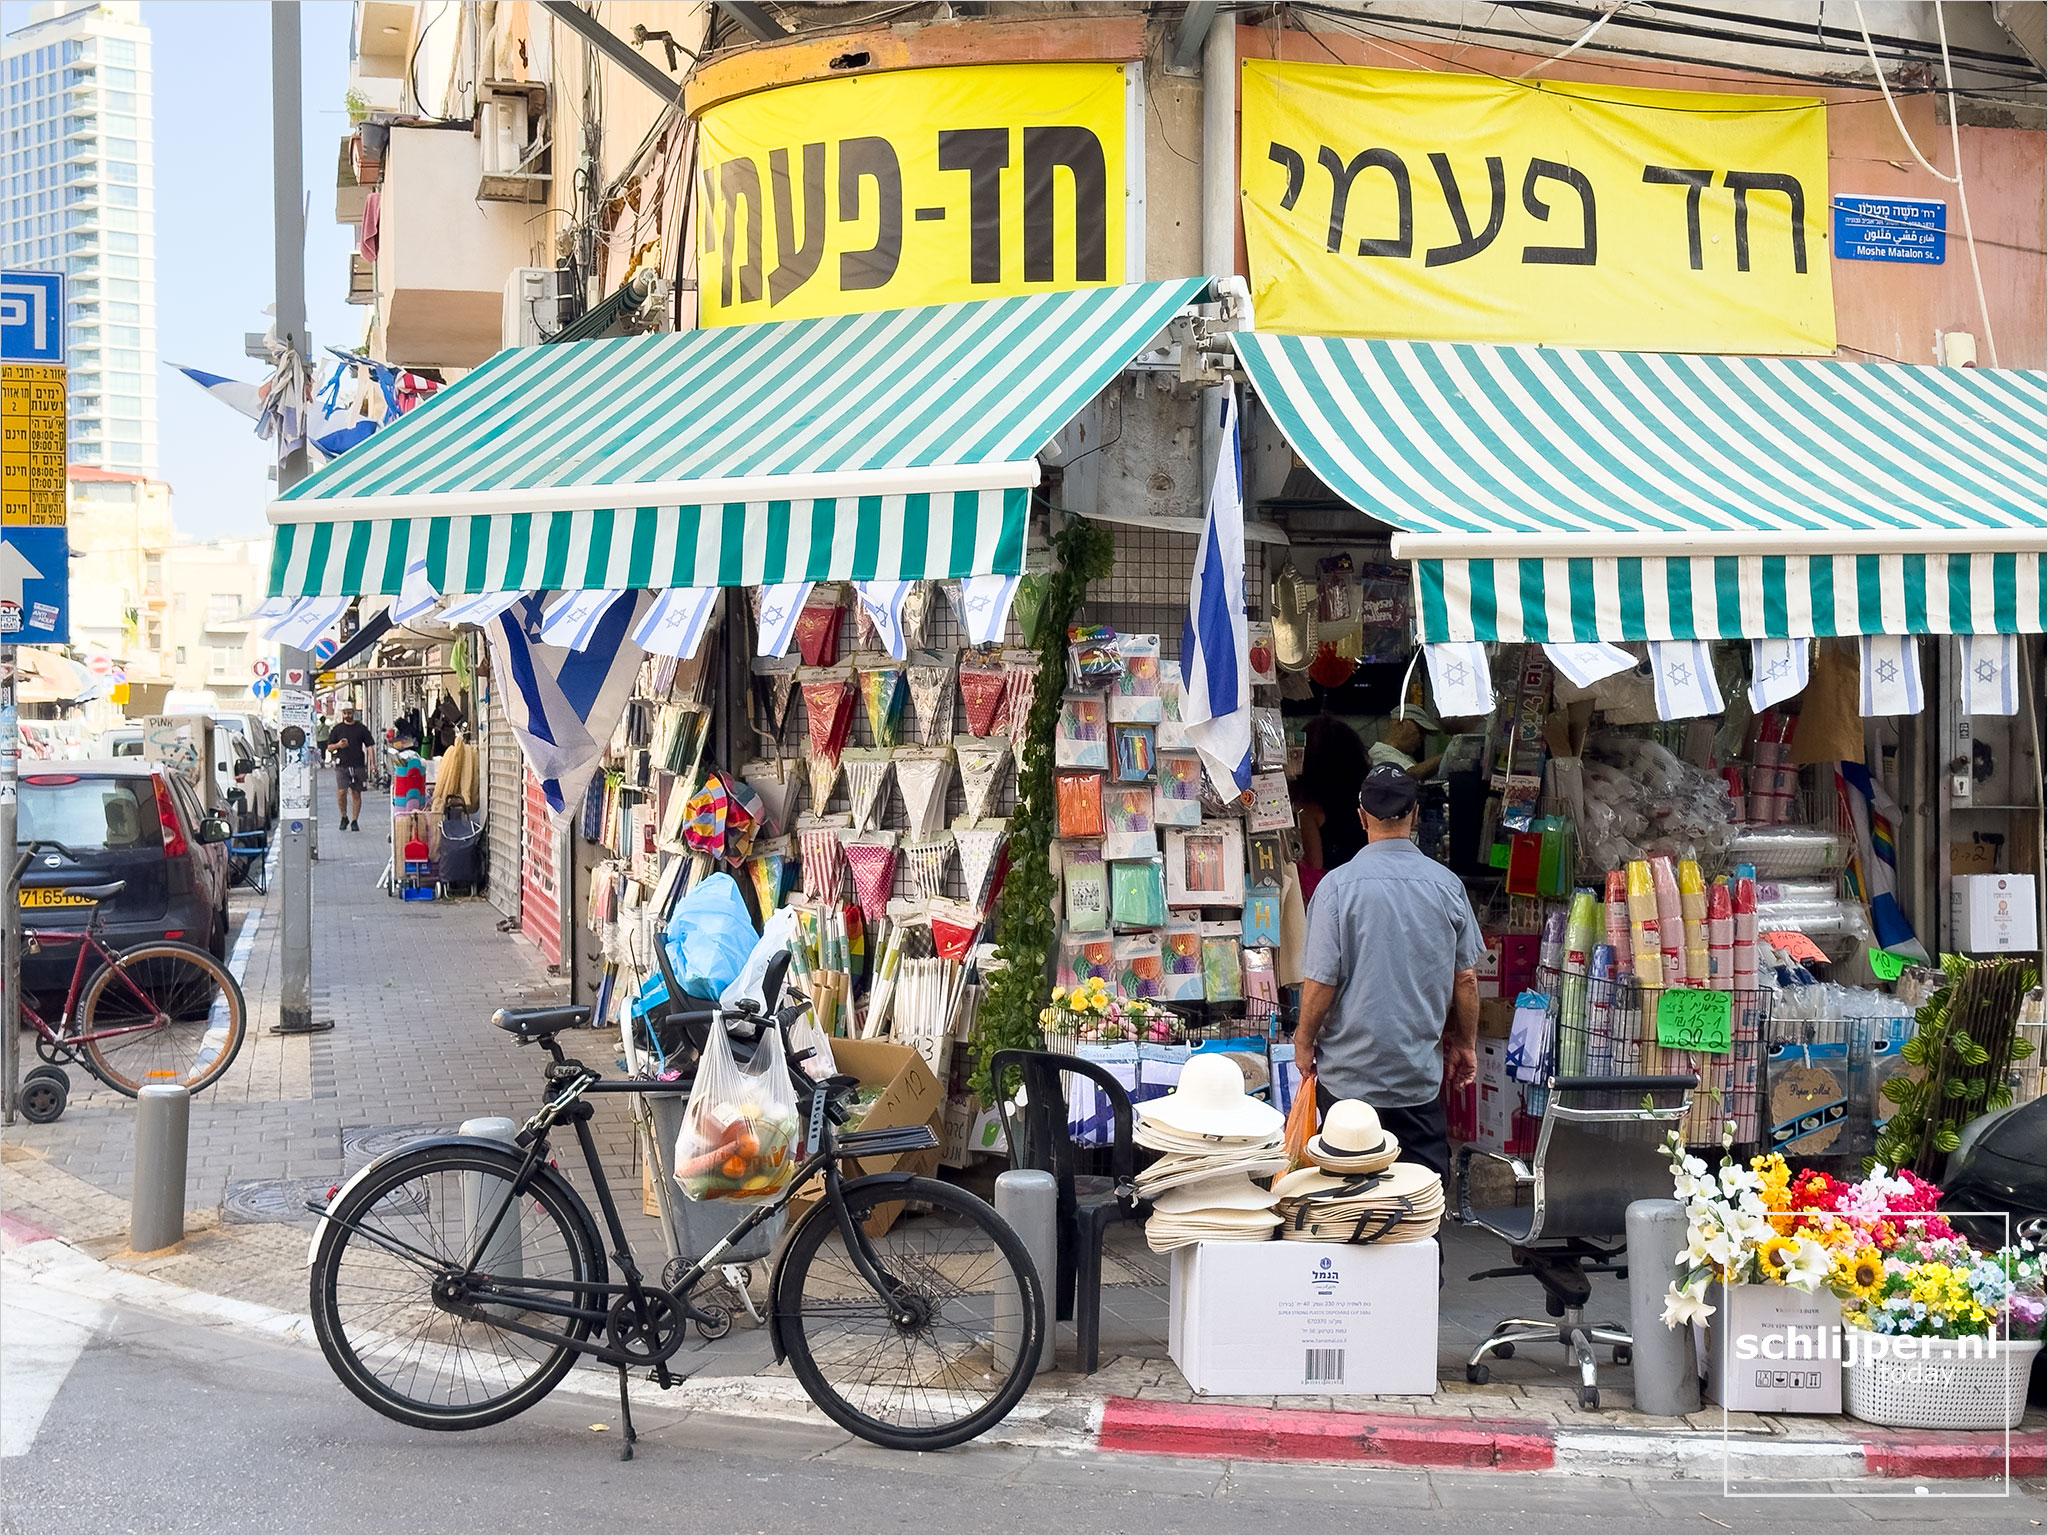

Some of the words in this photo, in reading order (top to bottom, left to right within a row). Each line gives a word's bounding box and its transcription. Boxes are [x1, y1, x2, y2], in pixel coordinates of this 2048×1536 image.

[1269, 141, 1598, 268] פעמי
[1642, 164, 1808, 274] חד
[1857, 246, 1886, 257] Moshe
[1888, 248, 1923, 259] Matalon
[36, 388, 59, 399] ימים
[31, 400, 64, 411] ושעות
[5, 429, 27, 440] חינם
[43, 455, 63, 466] ביום
[5, 465, 27, 477] חינם
[6, 503, 28, 514] חינם
[1258, 845, 1274, 870] H
[1255, 905, 1271, 929] H
[1259, 980, 1272, 1000] H
[1789, 1083, 1809, 1099] Paper
[1812, 1083, 1831, 1096] Mat
[1312, 1270, 1339, 1280] הנמל
